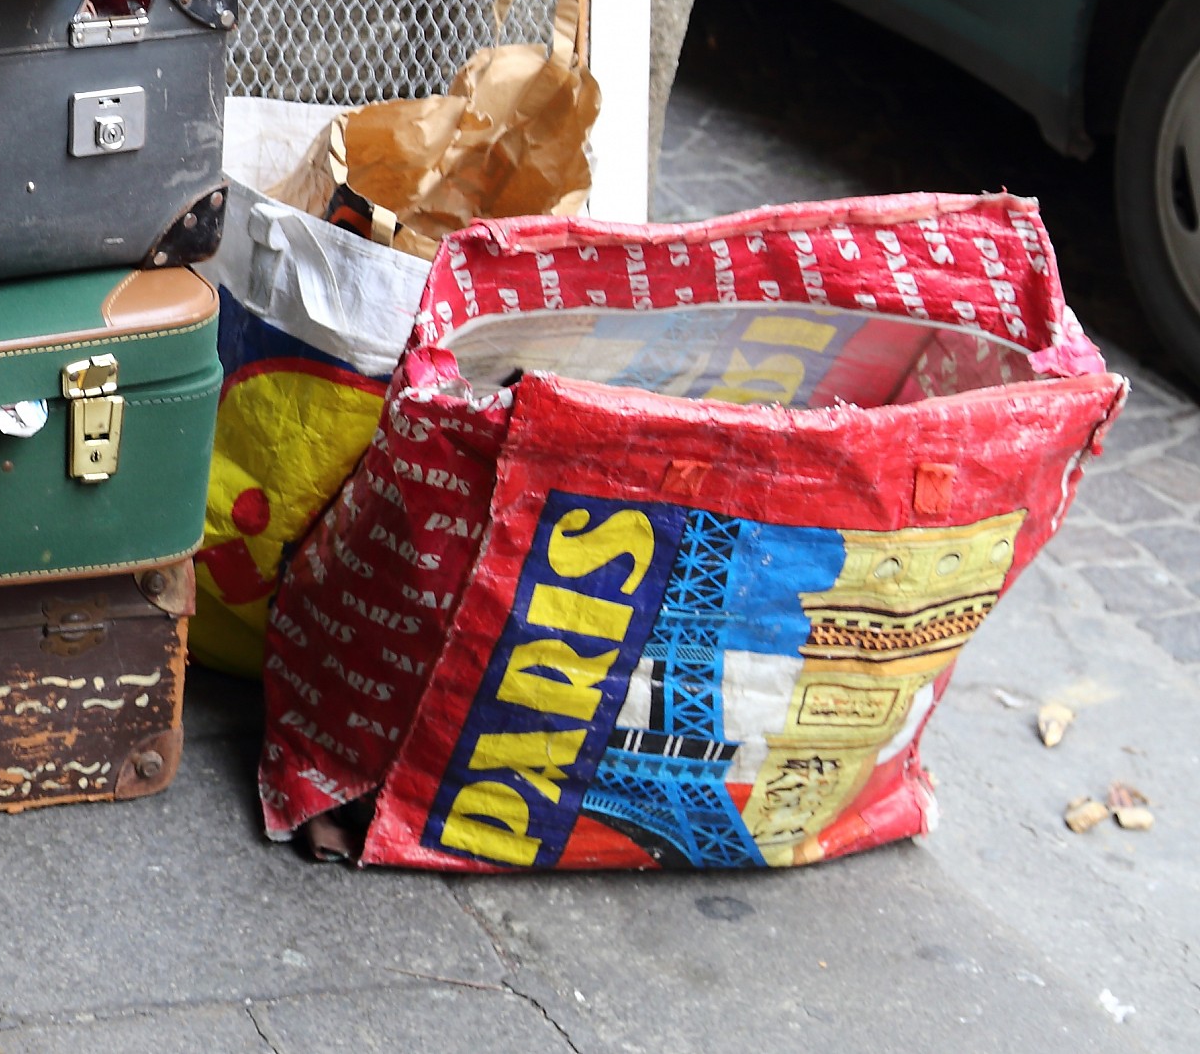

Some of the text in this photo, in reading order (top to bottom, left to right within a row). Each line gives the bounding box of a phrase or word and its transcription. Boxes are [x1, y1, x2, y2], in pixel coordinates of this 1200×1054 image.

[535, 251, 564, 310] ARIS
[973, 236, 1028, 339] PARIS
[392, 457, 472, 497] PARIS
[368, 522, 442, 570] PARIS
[342, 590, 422, 635] PARIS
[266, 653, 322, 707] PARIS
[321, 653, 396, 702] PARIS
[440, 508, 655, 867] PARIS
[279, 709, 360, 764] PARIS
